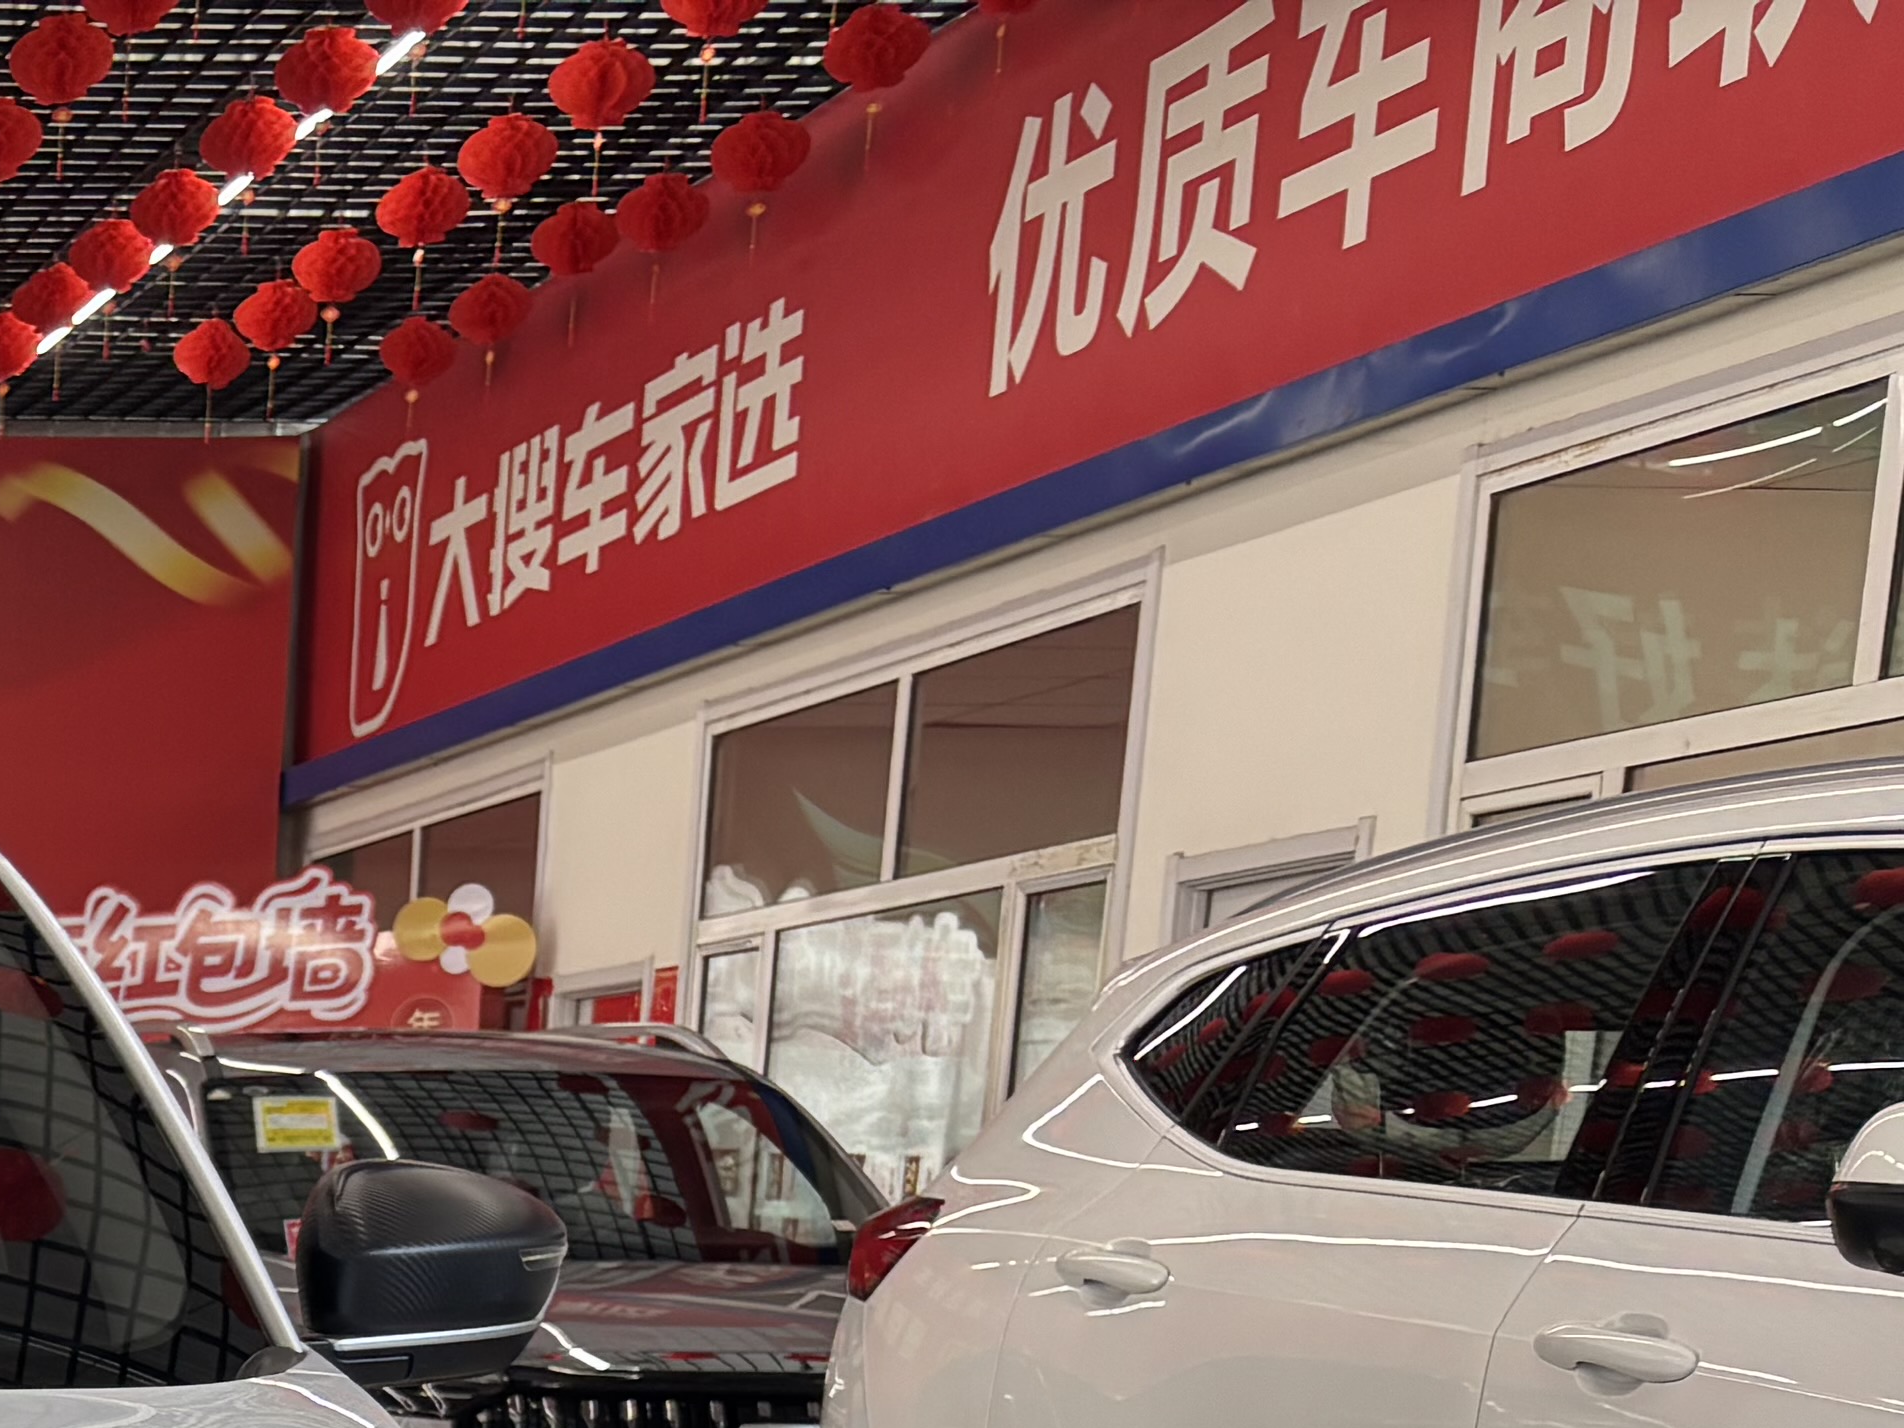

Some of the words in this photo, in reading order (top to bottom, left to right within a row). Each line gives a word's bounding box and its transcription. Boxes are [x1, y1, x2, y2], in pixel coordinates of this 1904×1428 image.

[988, 0, 1882, 397] 优质车商
[424, 296, 805, 647] 大搜车家选
